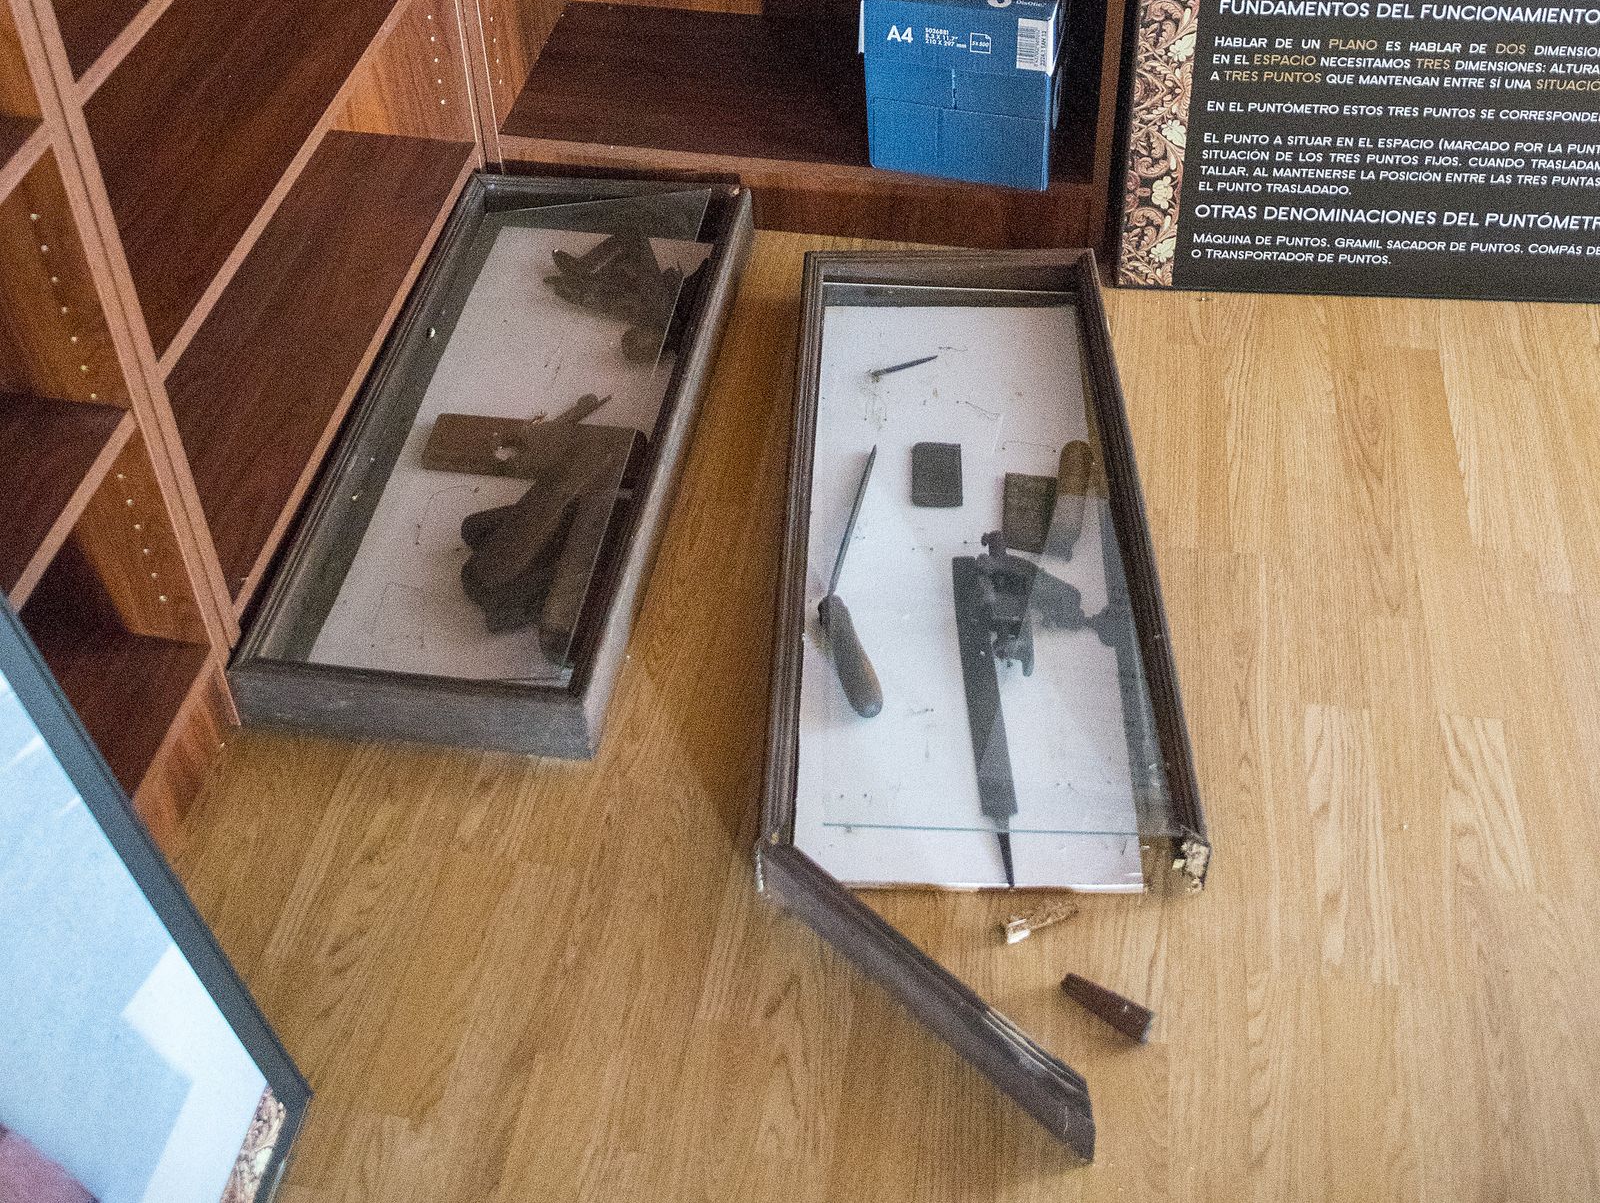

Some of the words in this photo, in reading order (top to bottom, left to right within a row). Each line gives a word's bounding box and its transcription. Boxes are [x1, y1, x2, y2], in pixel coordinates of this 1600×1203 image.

[1219, 0, 1370, 17] FUNDAMENTOS
[1376, 3, 1414, 18] DEL
[1420, 4, 1600, 23] FUNCIONAMIENTO
[886, 25, 913, 43] A4
[1214, 36, 1267, 48] HABLAR
[1275, 38, 1293, 49] DE
[1301, 39, 1321, 49] UN
[1328, 39, 1378, 50] PLANO
[1386, 41, 1401, 51] ES
[1409, 41, 1461, 53] HABLAR
[1469, 43, 1487, 54] DE
[1495, 43, 1526, 55] DOS
[1534, 45, 1600, 57] DIMENSIO
[1212, 54, 1230, 64] EN
[1234, 54, 1249, 65] EL
[1253, 54, 1316, 66] ESPACIO
[1320, 57, 1411, 69] NECESITAMOS
[1416, 58, 1450, 69] TRES
[1454, 60, 1546, 73] DIMENSIONES:
[1550, 63, 1600, 74] ALTURA
[1210, 71, 1220, 80] A
[1223, 71, 1258, 81] TRES
[1263, 71, 1322, 83] PUNTOS
[1326, 74, 1354, 84] QUE
[1359, 75, 1439, 87] MANTENGAN
[1443, 77, 1484, 88] ENTRE
[1489, 77, 1501, 88] SÍ
[1504, 79, 1532, 89] UNA
[1207, 100, 1225, 112] EN
[1229, 101, 1244, 112] EL
[1248, 102, 1339, 115] PUNTÓMETRO
[1343, 105, 1383, 115] ESTOS
[1387, 106, 1419, 117] TRES
[1423, 107, 1476, 118] PUNTOS
[1480, 108, 1495, 119] SE
[1203, 132, 1220, 143] EL
[1224, 133, 1270, 144] PUNTO
[1273, 135, 1282, 145] A
[1287, 136, 1332, 146] SITUAR
[1336, 137, 1354, 147] EN
[1358, 137, 1373, 147] EL
[1378, 138, 1434, 149] ESPACIO
[1439, 138, 1510, 151] (MARCADO
[1514, 142, 1543, 152] POR
[1547, 143, 1562, 153] LA
[1202, 149, 1269, 161] SITUACIÓN
[1275, 151, 1293, 161] DE
[1299, 152, 1323, 162] LOS
[1329, 152, 1360, 163] TRES
[1367, 154, 1419, 165] PUNTOS
[1424, 155, 1462, 166] FIJOS.
[1468, 157, 1525, 168] CUANDO
[1253, 167, 1268, 177] AL
[1272, 168, 1356, 179] MANTENERSE
[1360, 170, 1375, 180] LA
[1380, 170, 1442, 182] POSICIÓN
[1445, 172, 1486, 183] ENTRE
[1490, 174, 1512, 184] LAS
[1516, 175, 1547, 185] TRES
[1552, 176, 1600, 186] PUNTAS
[1198, 181, 1213, 191] EL
[1217, 181, 1262, 192] PUNTO
[1266, 183, 1352, 195] TRASLADADO.
[1195, 204, 1257, 219] OTRAS
[1264, 206, 1437, 225] DENOMINACIONES
[1442, 211, 1479, 226] DEL
[1193, 232, 1251, 244] MÁQUINA
[1255, 235, 1272, 245] DE
[1334, 237, 1383, 249] GRAMIL
[1386, 240, 1446, 251] SACADOR
[1450, 242, 1467, 251] DE
[1528, 243, 1582, 255] COMPÁS
[1191, 249, 1202, 258] O
[1205, 248, 1314, 263] TRANSPORTADOR
[1317, 253, 1335, 263] DE
[1338, 254, 1392, 265] PUNTOS.
